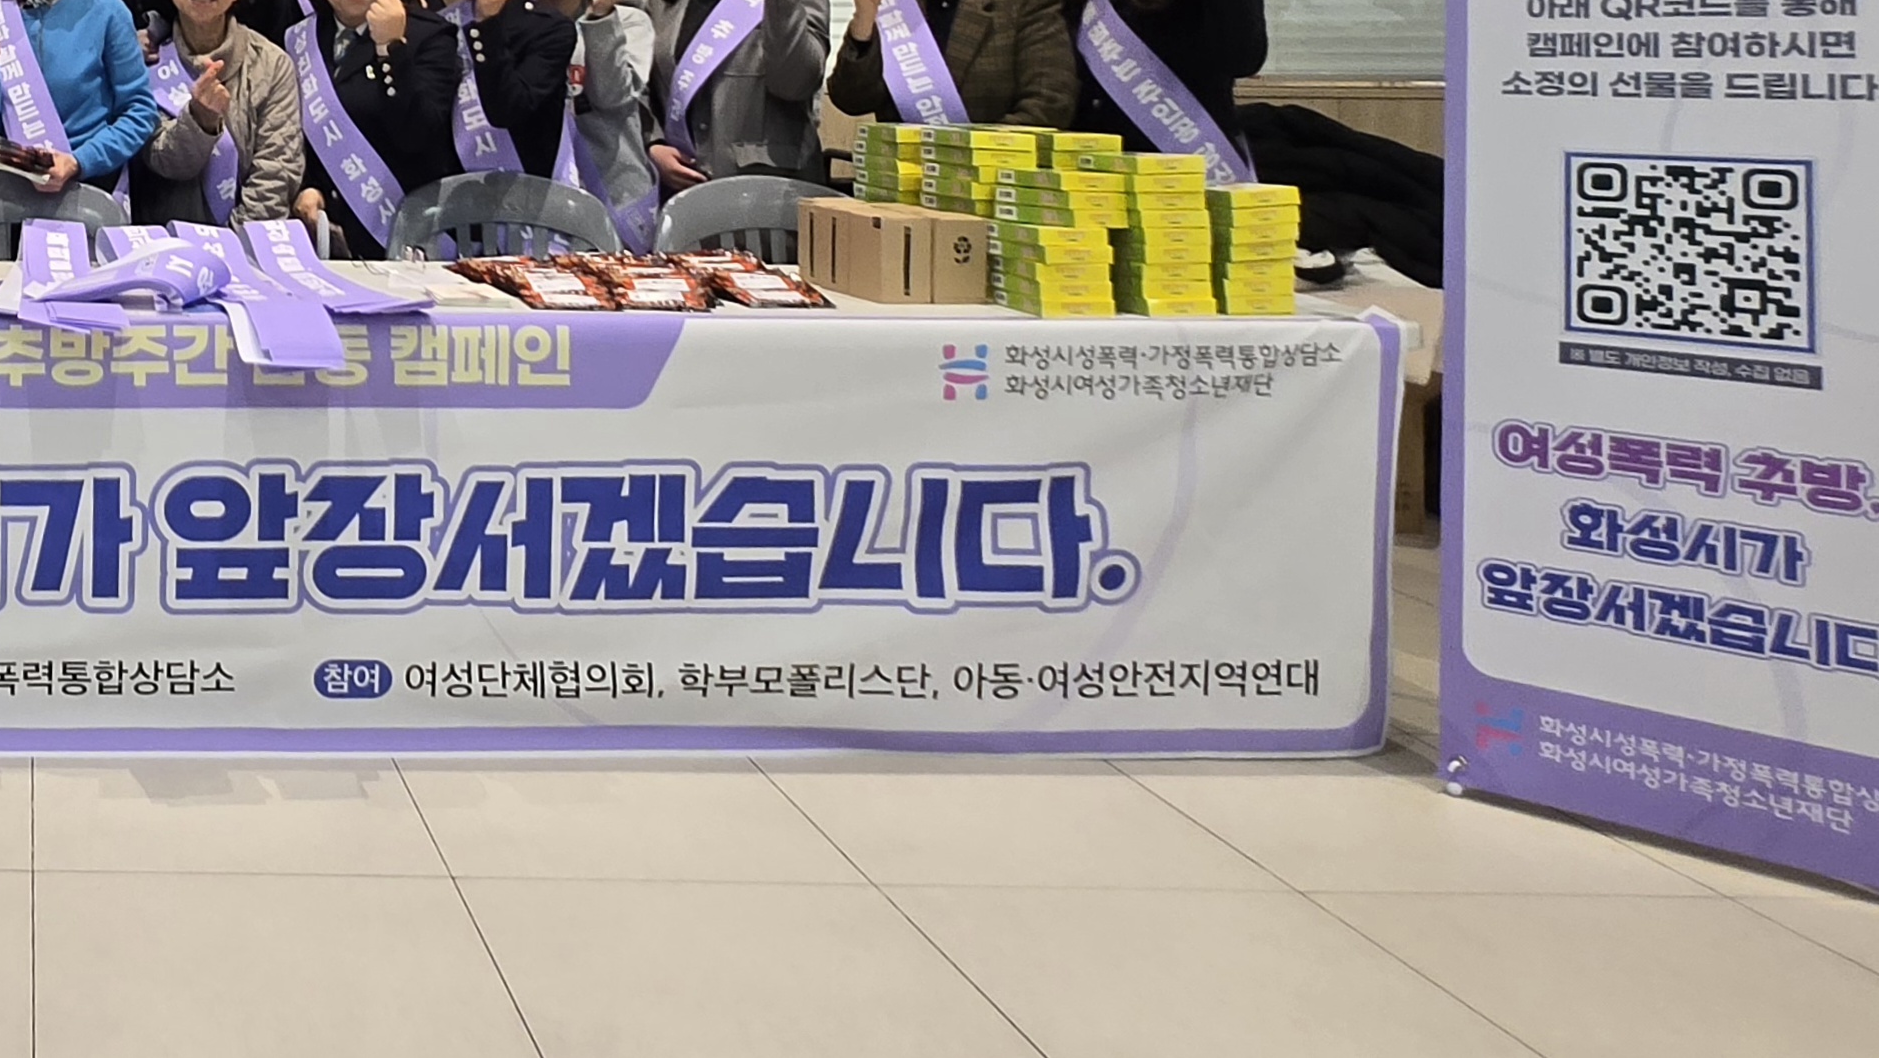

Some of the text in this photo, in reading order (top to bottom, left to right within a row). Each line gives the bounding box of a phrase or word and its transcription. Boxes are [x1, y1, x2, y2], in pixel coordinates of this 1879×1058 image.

[878, 9, 912, 42] 함께
[1526, 30, 1857, 59] 캠페인에 참여하시면
[891, 41, 934, 94] 만드는
[1501, 71, 1599, 97] 소정의
[1609, 71, 1714, 99] 선물을
[7, 81, 47, 140] 만드는
[339, 152, 397, 226] 화성시
[253, 326, 370, 388] 동
[390, 324, 572, 388] 캠페인
[1002, 343, 1344, 368] 화성시성폭력·가정폭력통합상담소
[1588, 349, 1621, 365] 별도
[1625, 351, 1691, 373] 개인정보
[1693, 359, 1731, 378] 작성,
[1735, 363, 1770, 381] 수집
[1773, 367, 1811, 385] 없음
[1002, 373, 1275, 398] 화성시여성가족청소년재단
[1498, 426, 1723, 493] 여성폭력
[160, 468, 1130, 606] 앞장서겠습니다.
[1566, 501, 1806, 582] 화성시가
[322, 658, 1320, 701] 참여 여성단체협의회, 학부모폴리스단, 아동·여성안전지역연대
[1538, 741, 1854, 835] 화성시여성가족청소년재단
